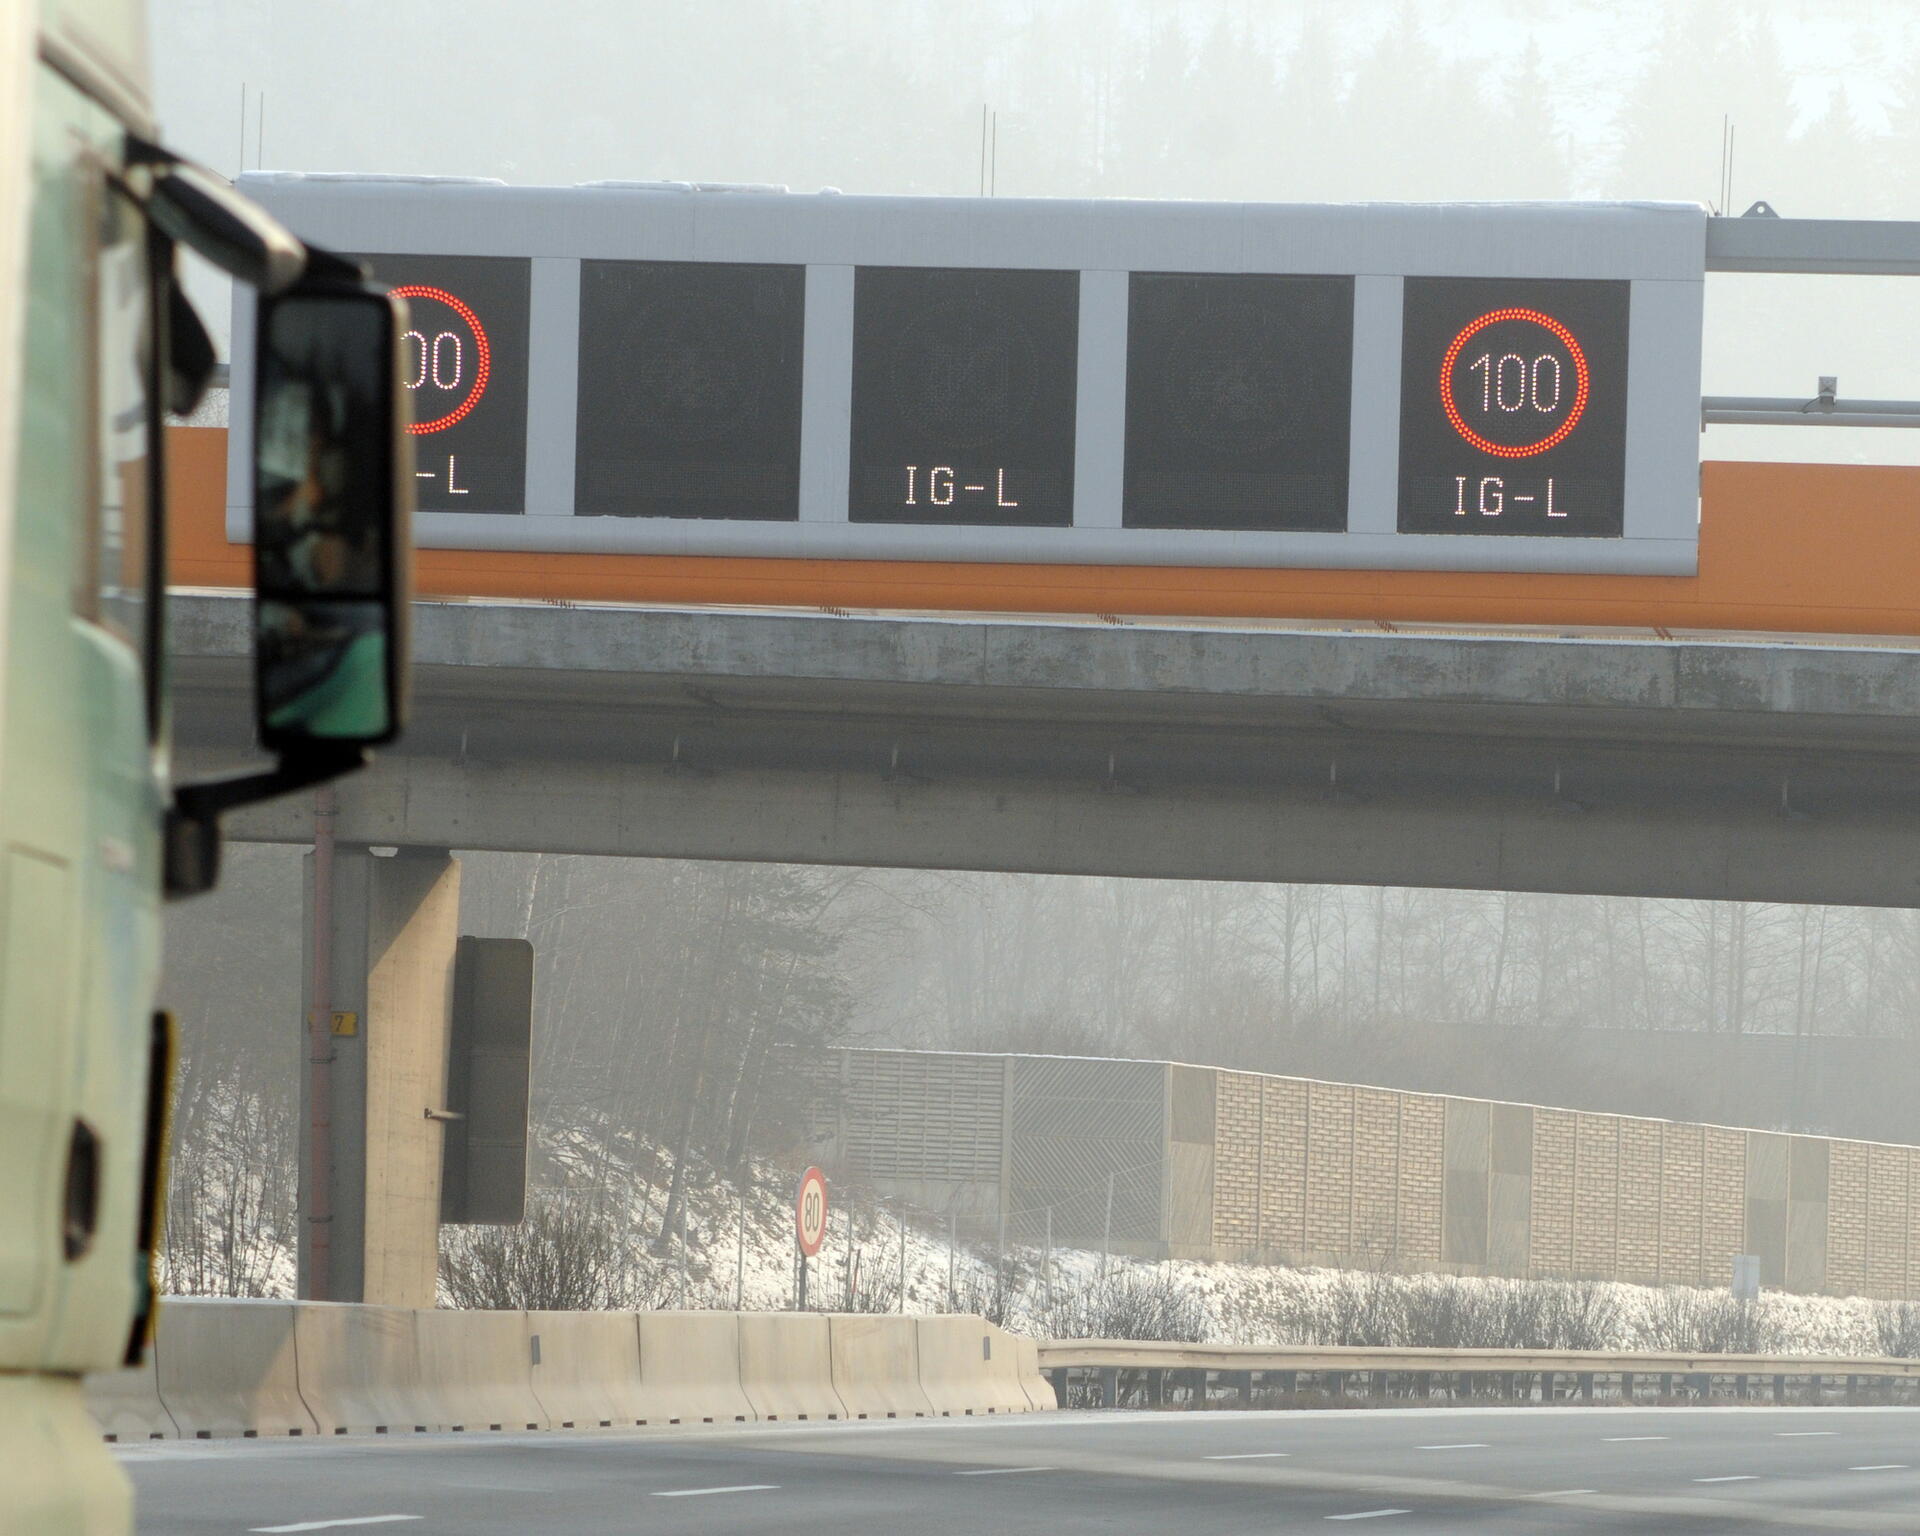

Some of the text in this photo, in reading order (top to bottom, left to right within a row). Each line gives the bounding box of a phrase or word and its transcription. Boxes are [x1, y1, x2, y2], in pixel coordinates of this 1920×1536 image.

[400, 330, 461, 391] 00
[1469, 353, 1560, 412] 100
[905, 465, 1018, 507] IG-L
[1454, 476, 1568, 518] IG-L
[805, 1193, 819, 1231] 80
